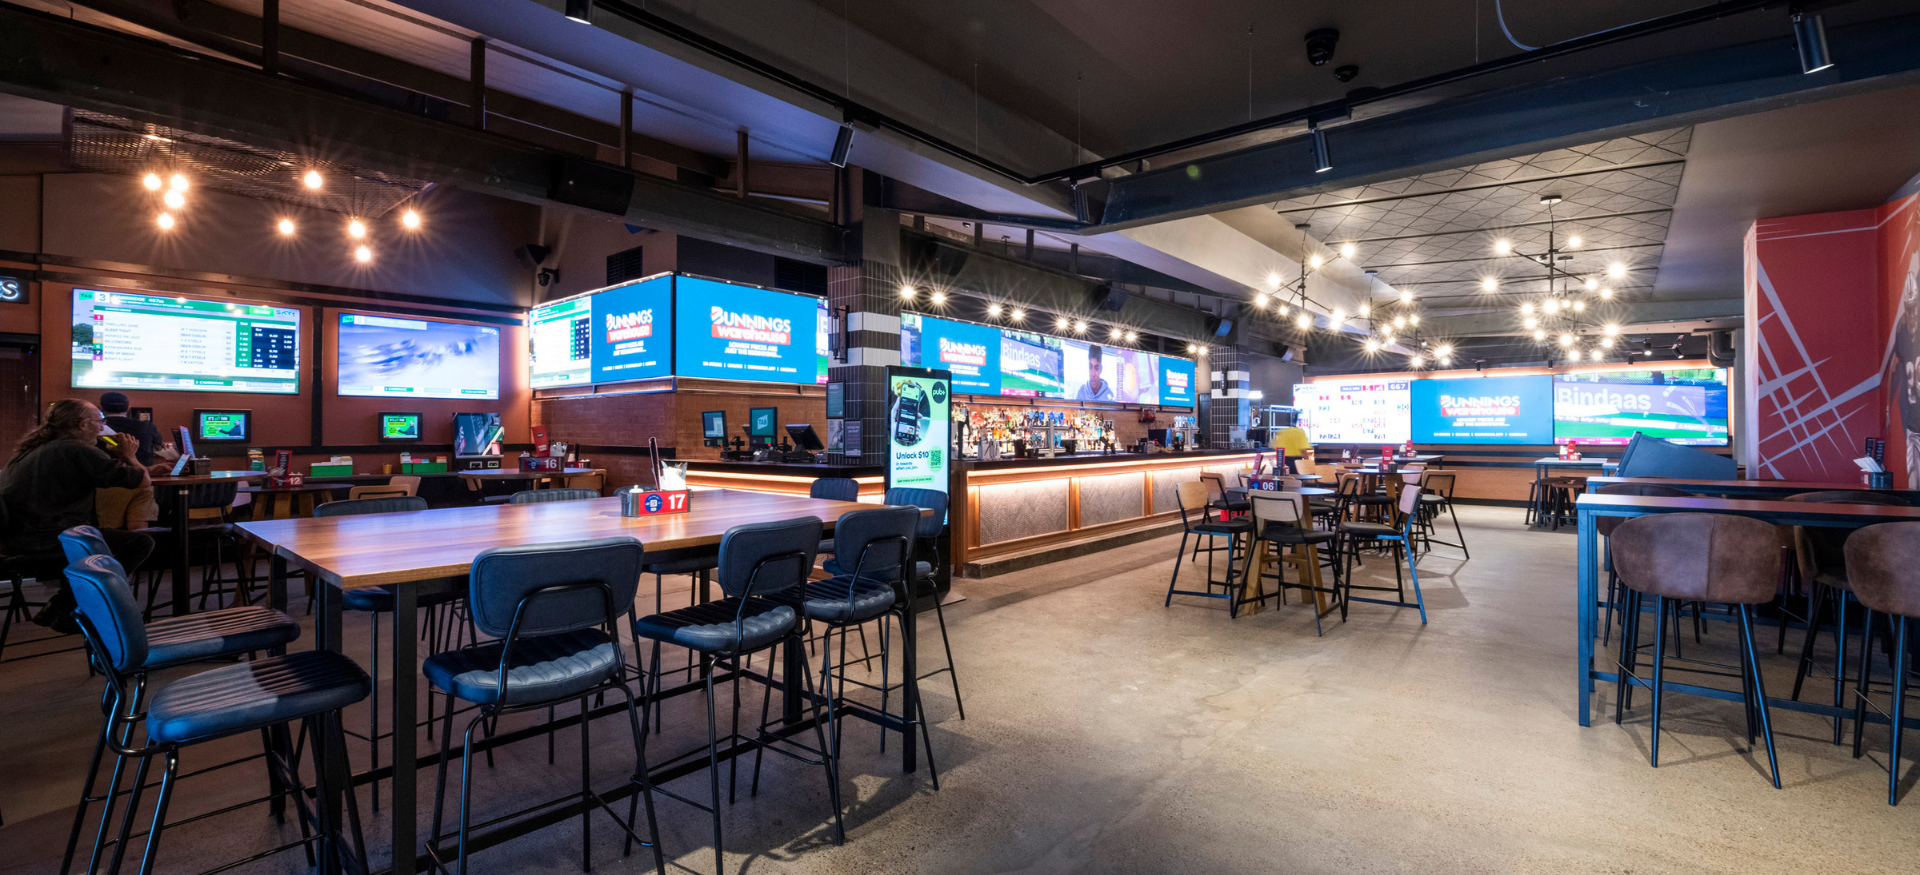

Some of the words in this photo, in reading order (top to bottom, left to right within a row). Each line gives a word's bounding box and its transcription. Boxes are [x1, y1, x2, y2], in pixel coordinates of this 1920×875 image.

[606, 308, 652, 330] BUNNINGS
[710, 306, 791, 333] BUNNINGS
[717, 326, 787, 344] warehouse
[939, 338, 986, 356] BUNNINGS
[1002, 342, 1040, 368] Bindaas
[933, 388, 945, 396] pub+
[1558, 387, 1651, 410] Bindaas
[1440, 395, 1520, 407] BUNNINGS
[1446, 406, 1515, 416] warehouse
[544, 459, 557, 468] 16
[289, 477, 300, 485] 12
[1262, 482, 1274, 490] 06
[668, 494, 686, 509] 17
